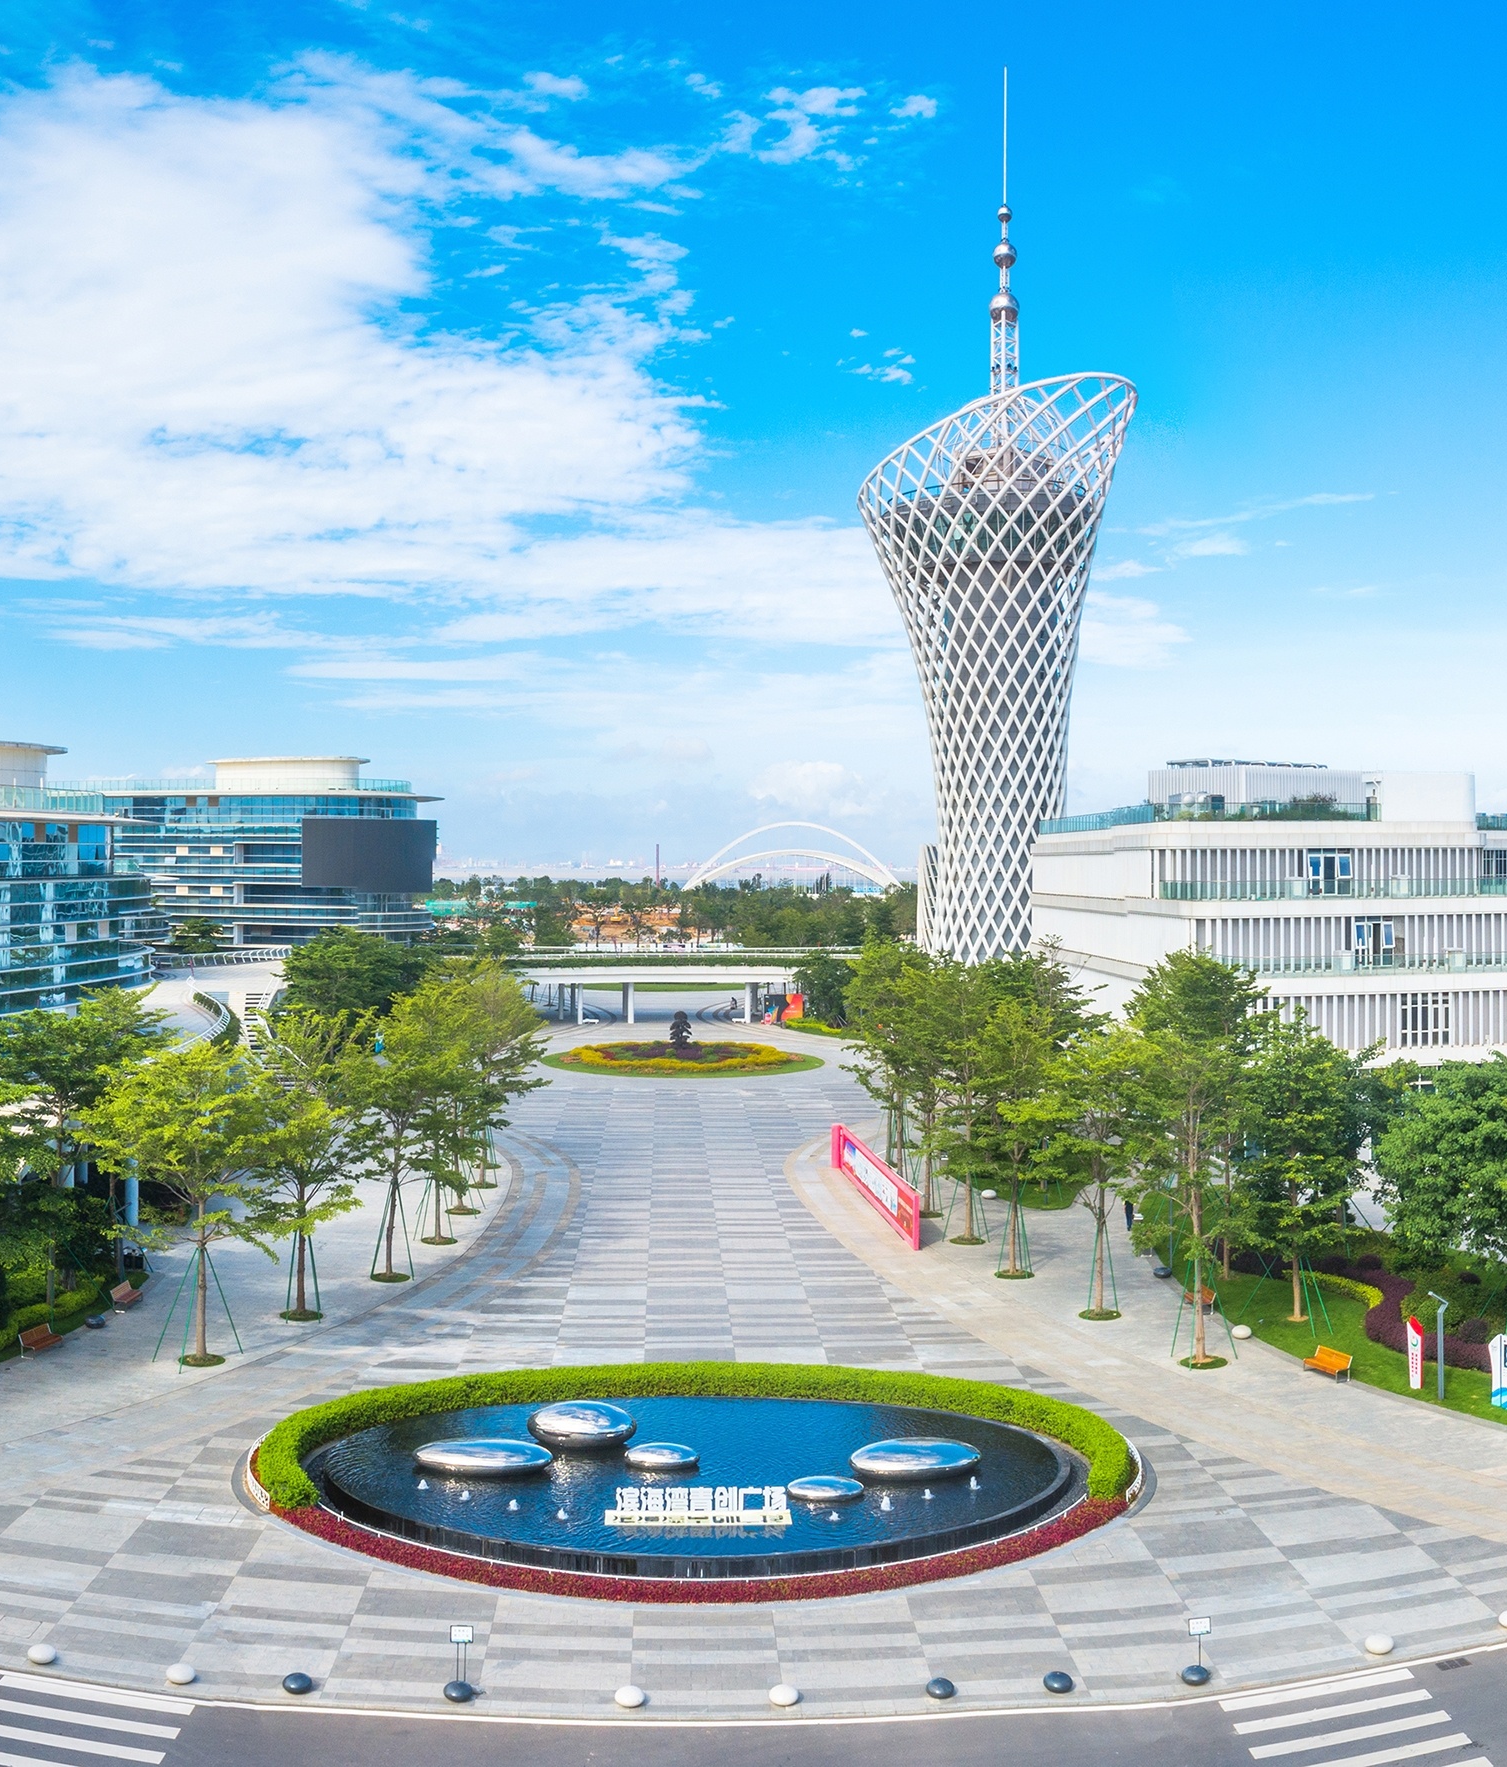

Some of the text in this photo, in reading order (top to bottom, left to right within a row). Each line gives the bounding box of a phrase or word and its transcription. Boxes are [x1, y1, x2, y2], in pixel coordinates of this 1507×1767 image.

[616, 1486, 787, 1512] 滨海湾青创广场
